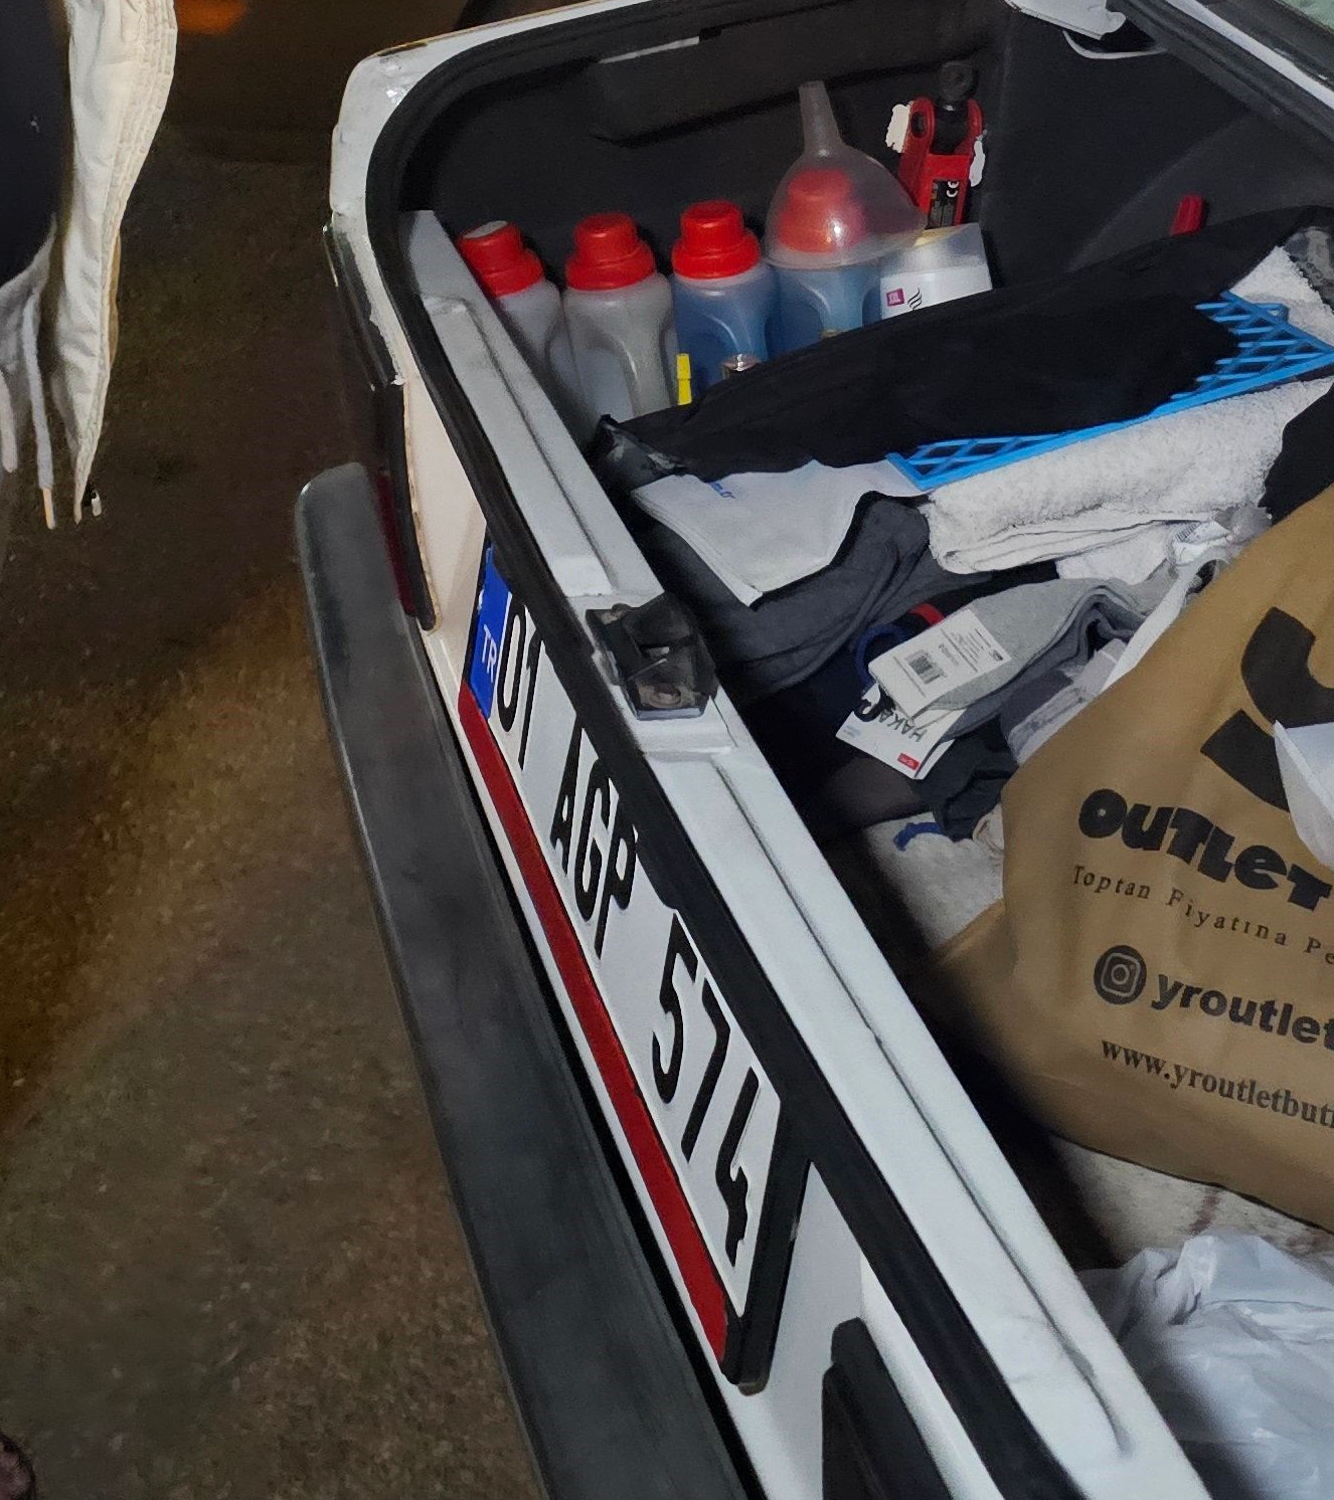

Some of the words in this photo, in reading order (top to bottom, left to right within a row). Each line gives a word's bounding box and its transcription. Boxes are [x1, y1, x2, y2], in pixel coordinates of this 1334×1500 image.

[482, 624, 497, 684] TR
[1074, 865, 1150, 900] Toptan
[497, 602, 543, 772] 01
[550, 715, 638, 961] AGP
[653, 912, 760, 1268] 574
